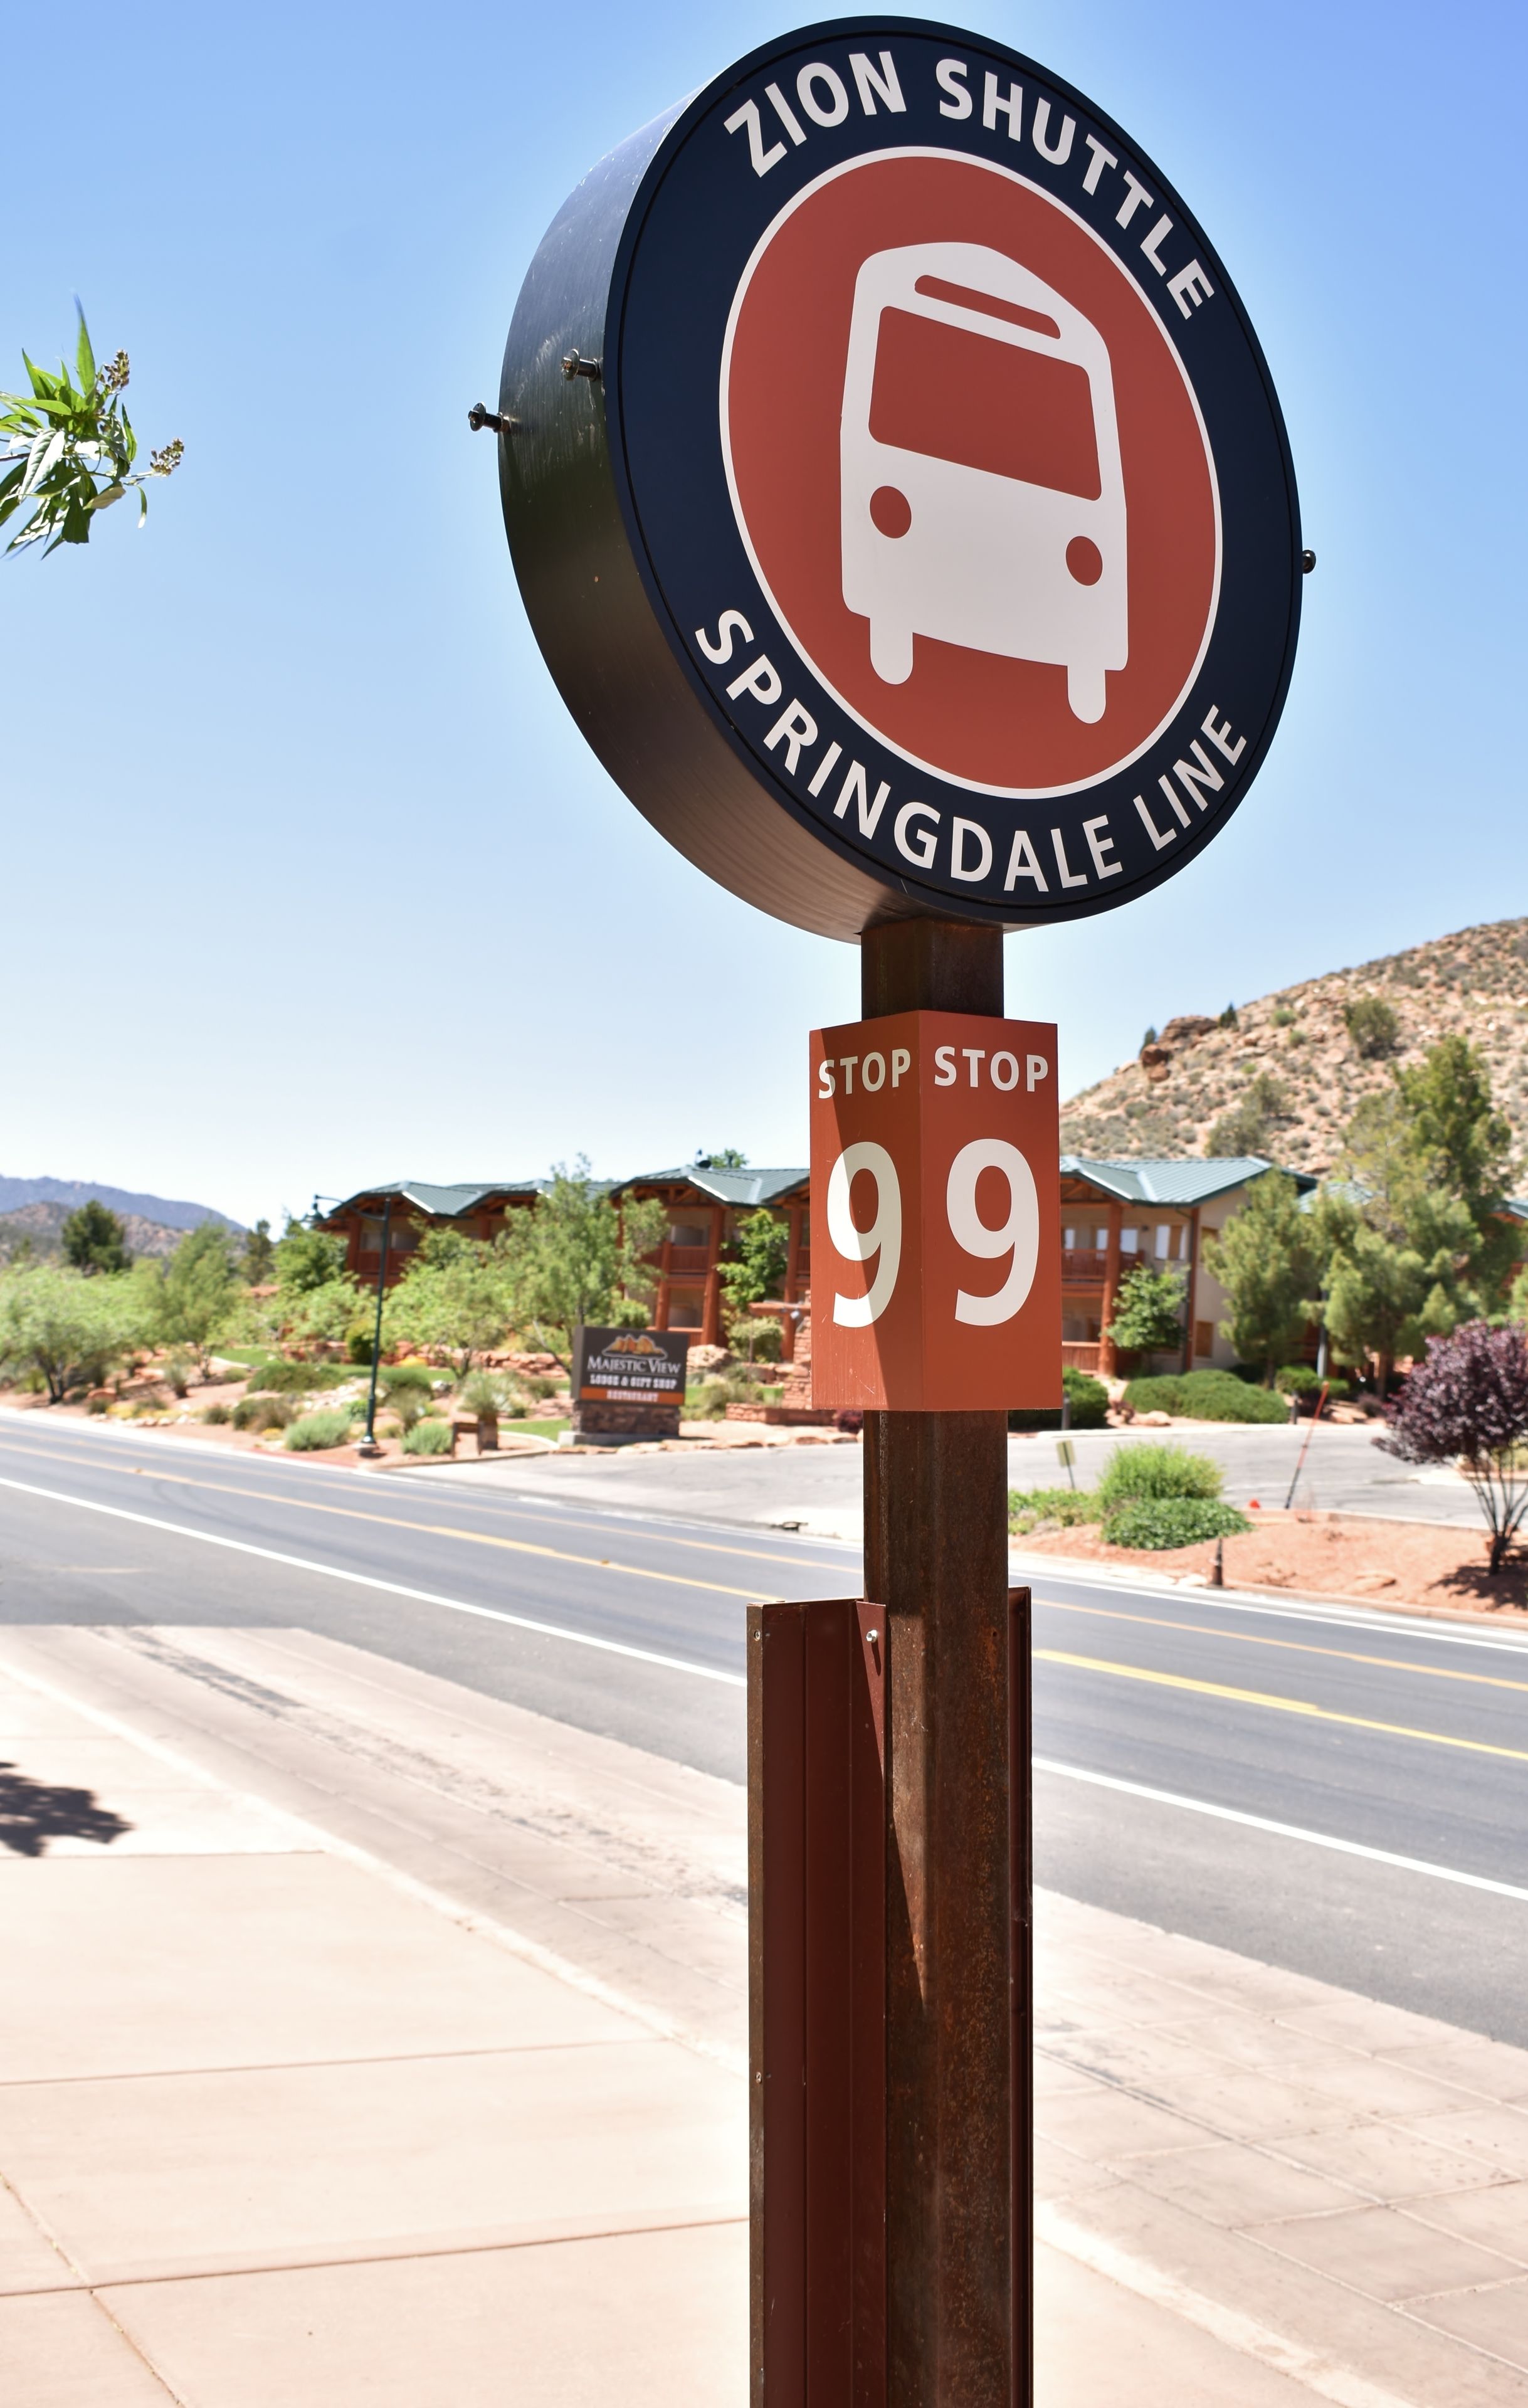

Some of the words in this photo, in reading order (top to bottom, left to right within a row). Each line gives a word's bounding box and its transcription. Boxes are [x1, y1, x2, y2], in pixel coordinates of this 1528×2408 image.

[724, 51, 907, 179] ZION
[935, 58, 1215, 320] SHUTTLE
[695, 609, 1124, 892] SPRINGDALE
[1132, 704, 1247, 851] LINE
[818, 1048, 910, 1099] STOP
[934, 1046, 1049, 1092] STOP
[826, 1141, 902, 1328] 9
[946, 1138, 1040, 1326] 9
[587, 1356, 647, 1371] MAJESTIC
[648, 1358, 681, 1374] VIEW
[590, 1373, 620, 1386] LODGE
[621, 1376, 629, 1386] &
[630, 1376, 652, 1388] GIFT
[653, 1378, 677, 1390] SHOP
